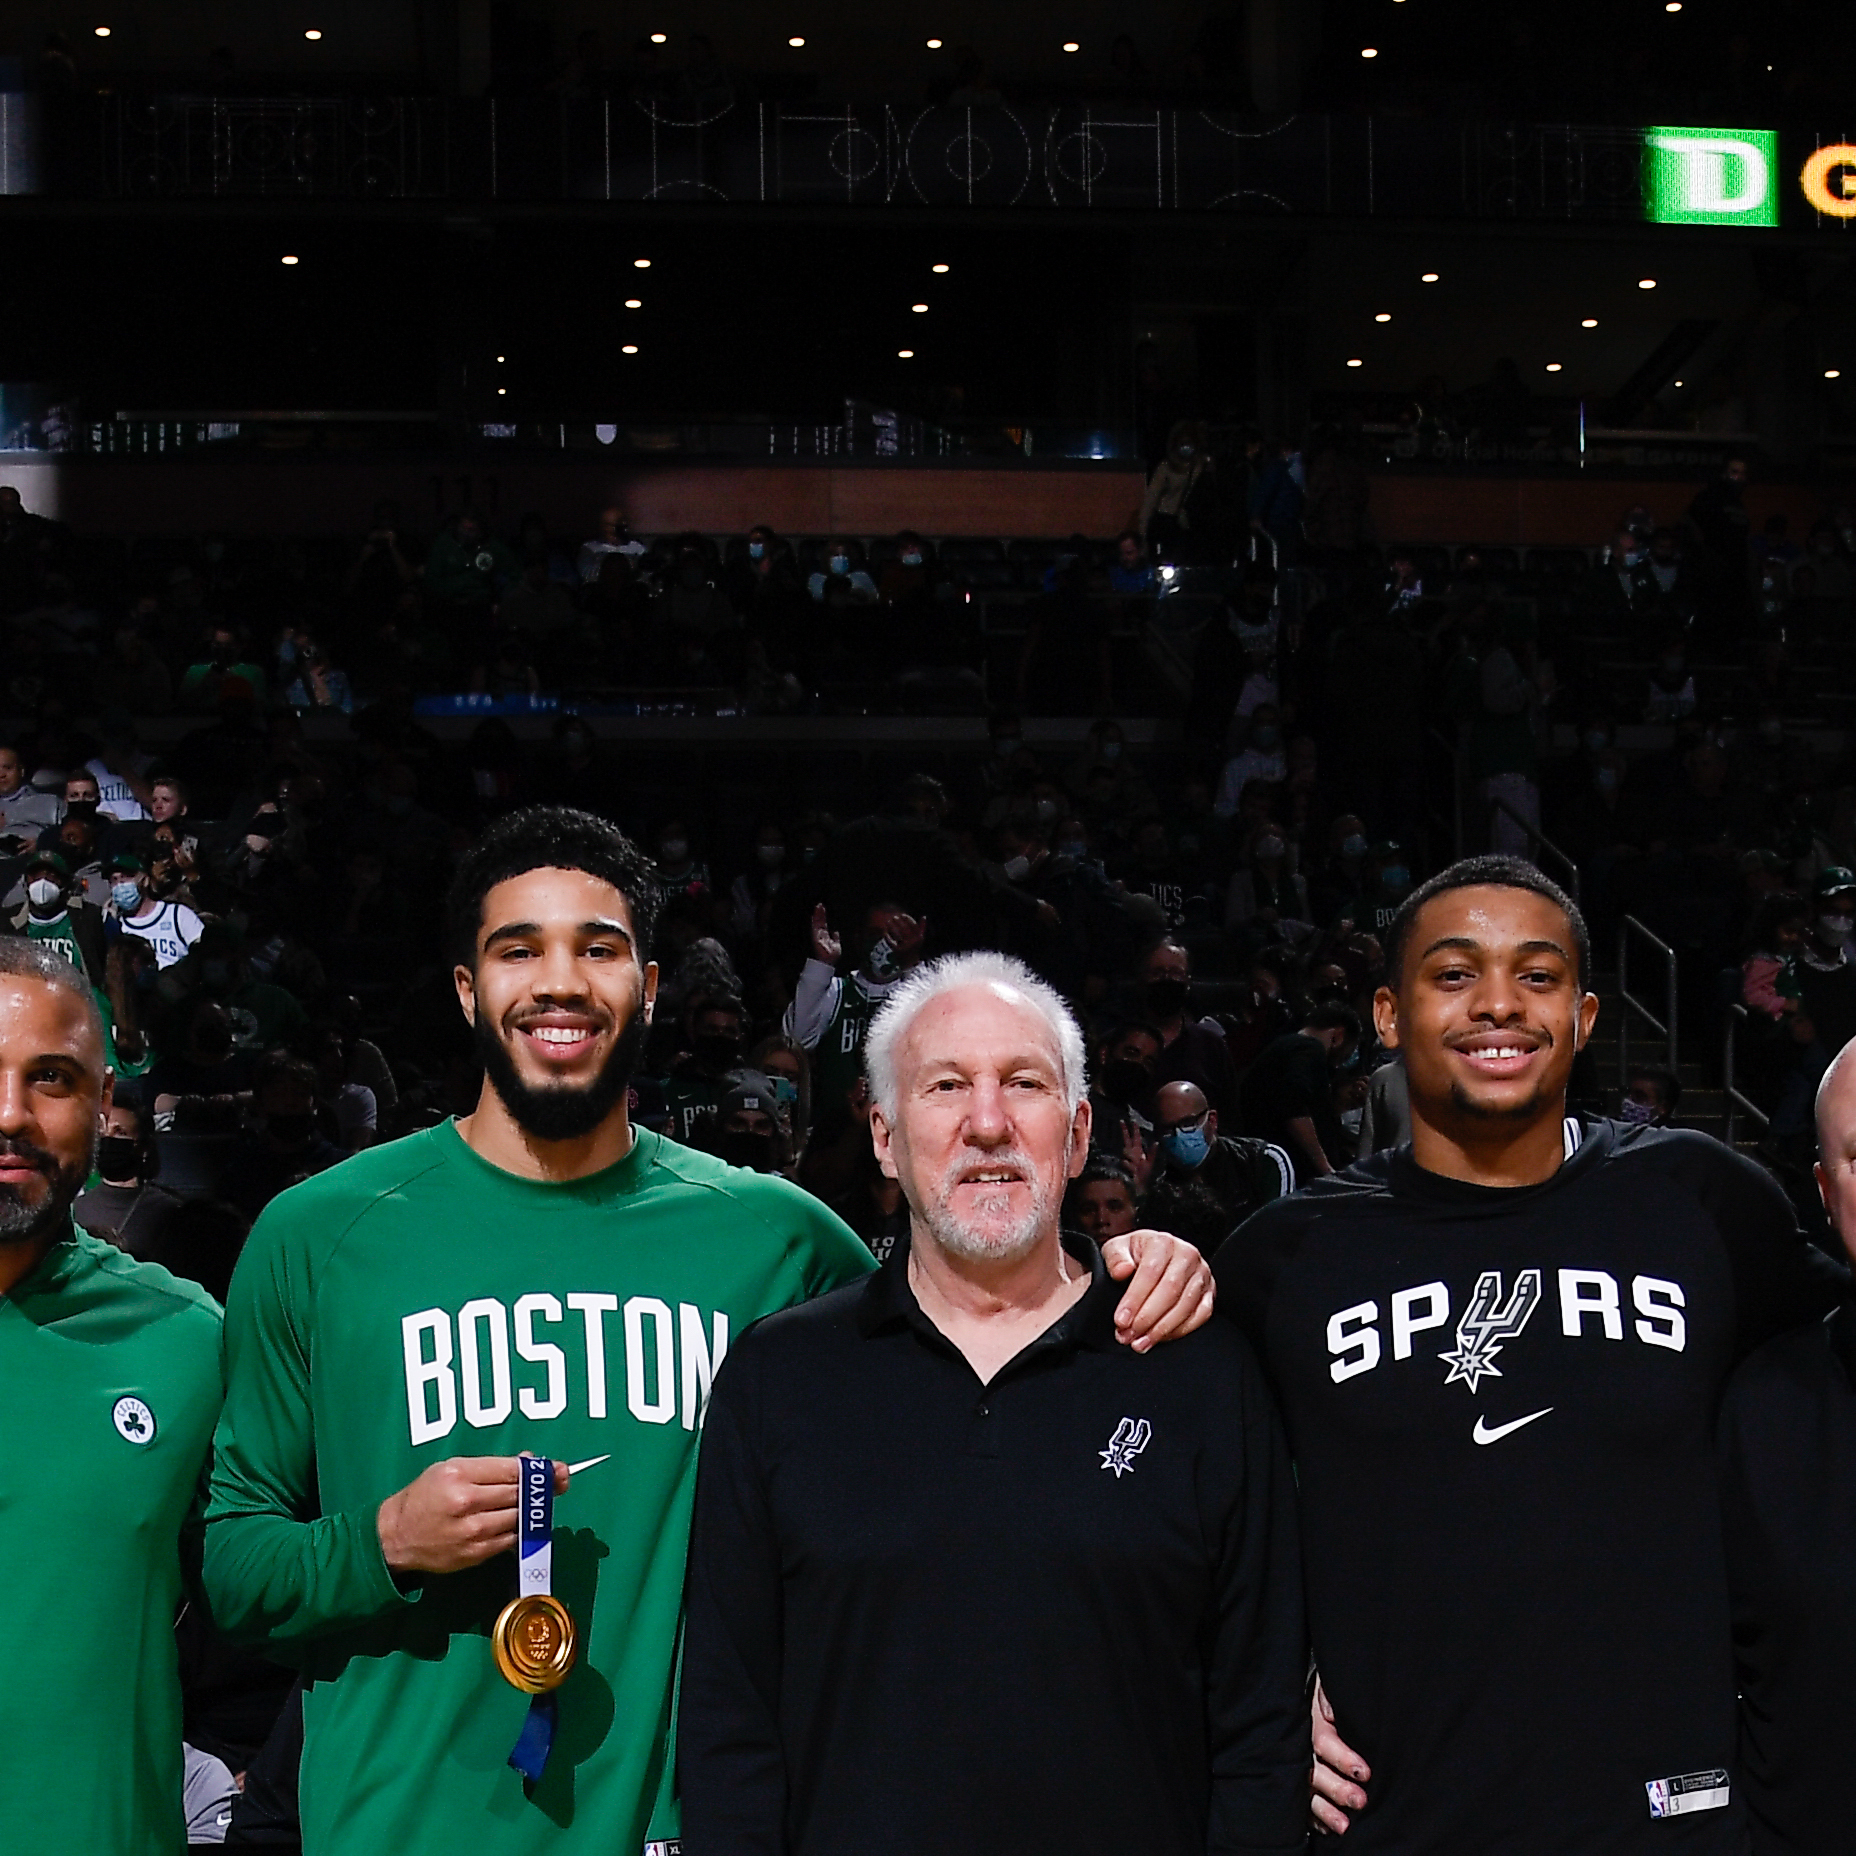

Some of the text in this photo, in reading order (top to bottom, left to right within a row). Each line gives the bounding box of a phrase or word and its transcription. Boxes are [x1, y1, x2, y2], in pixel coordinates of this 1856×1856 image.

[1658, 136, 1771, 217] TD
[401, 1292, 730, 1447] BOSTON
[1326, 1267, 1687, 1396] SPURS
[116, 1400, 151, 1423] CELTICS
[529, 1473, 545, 1532] TOKYO
